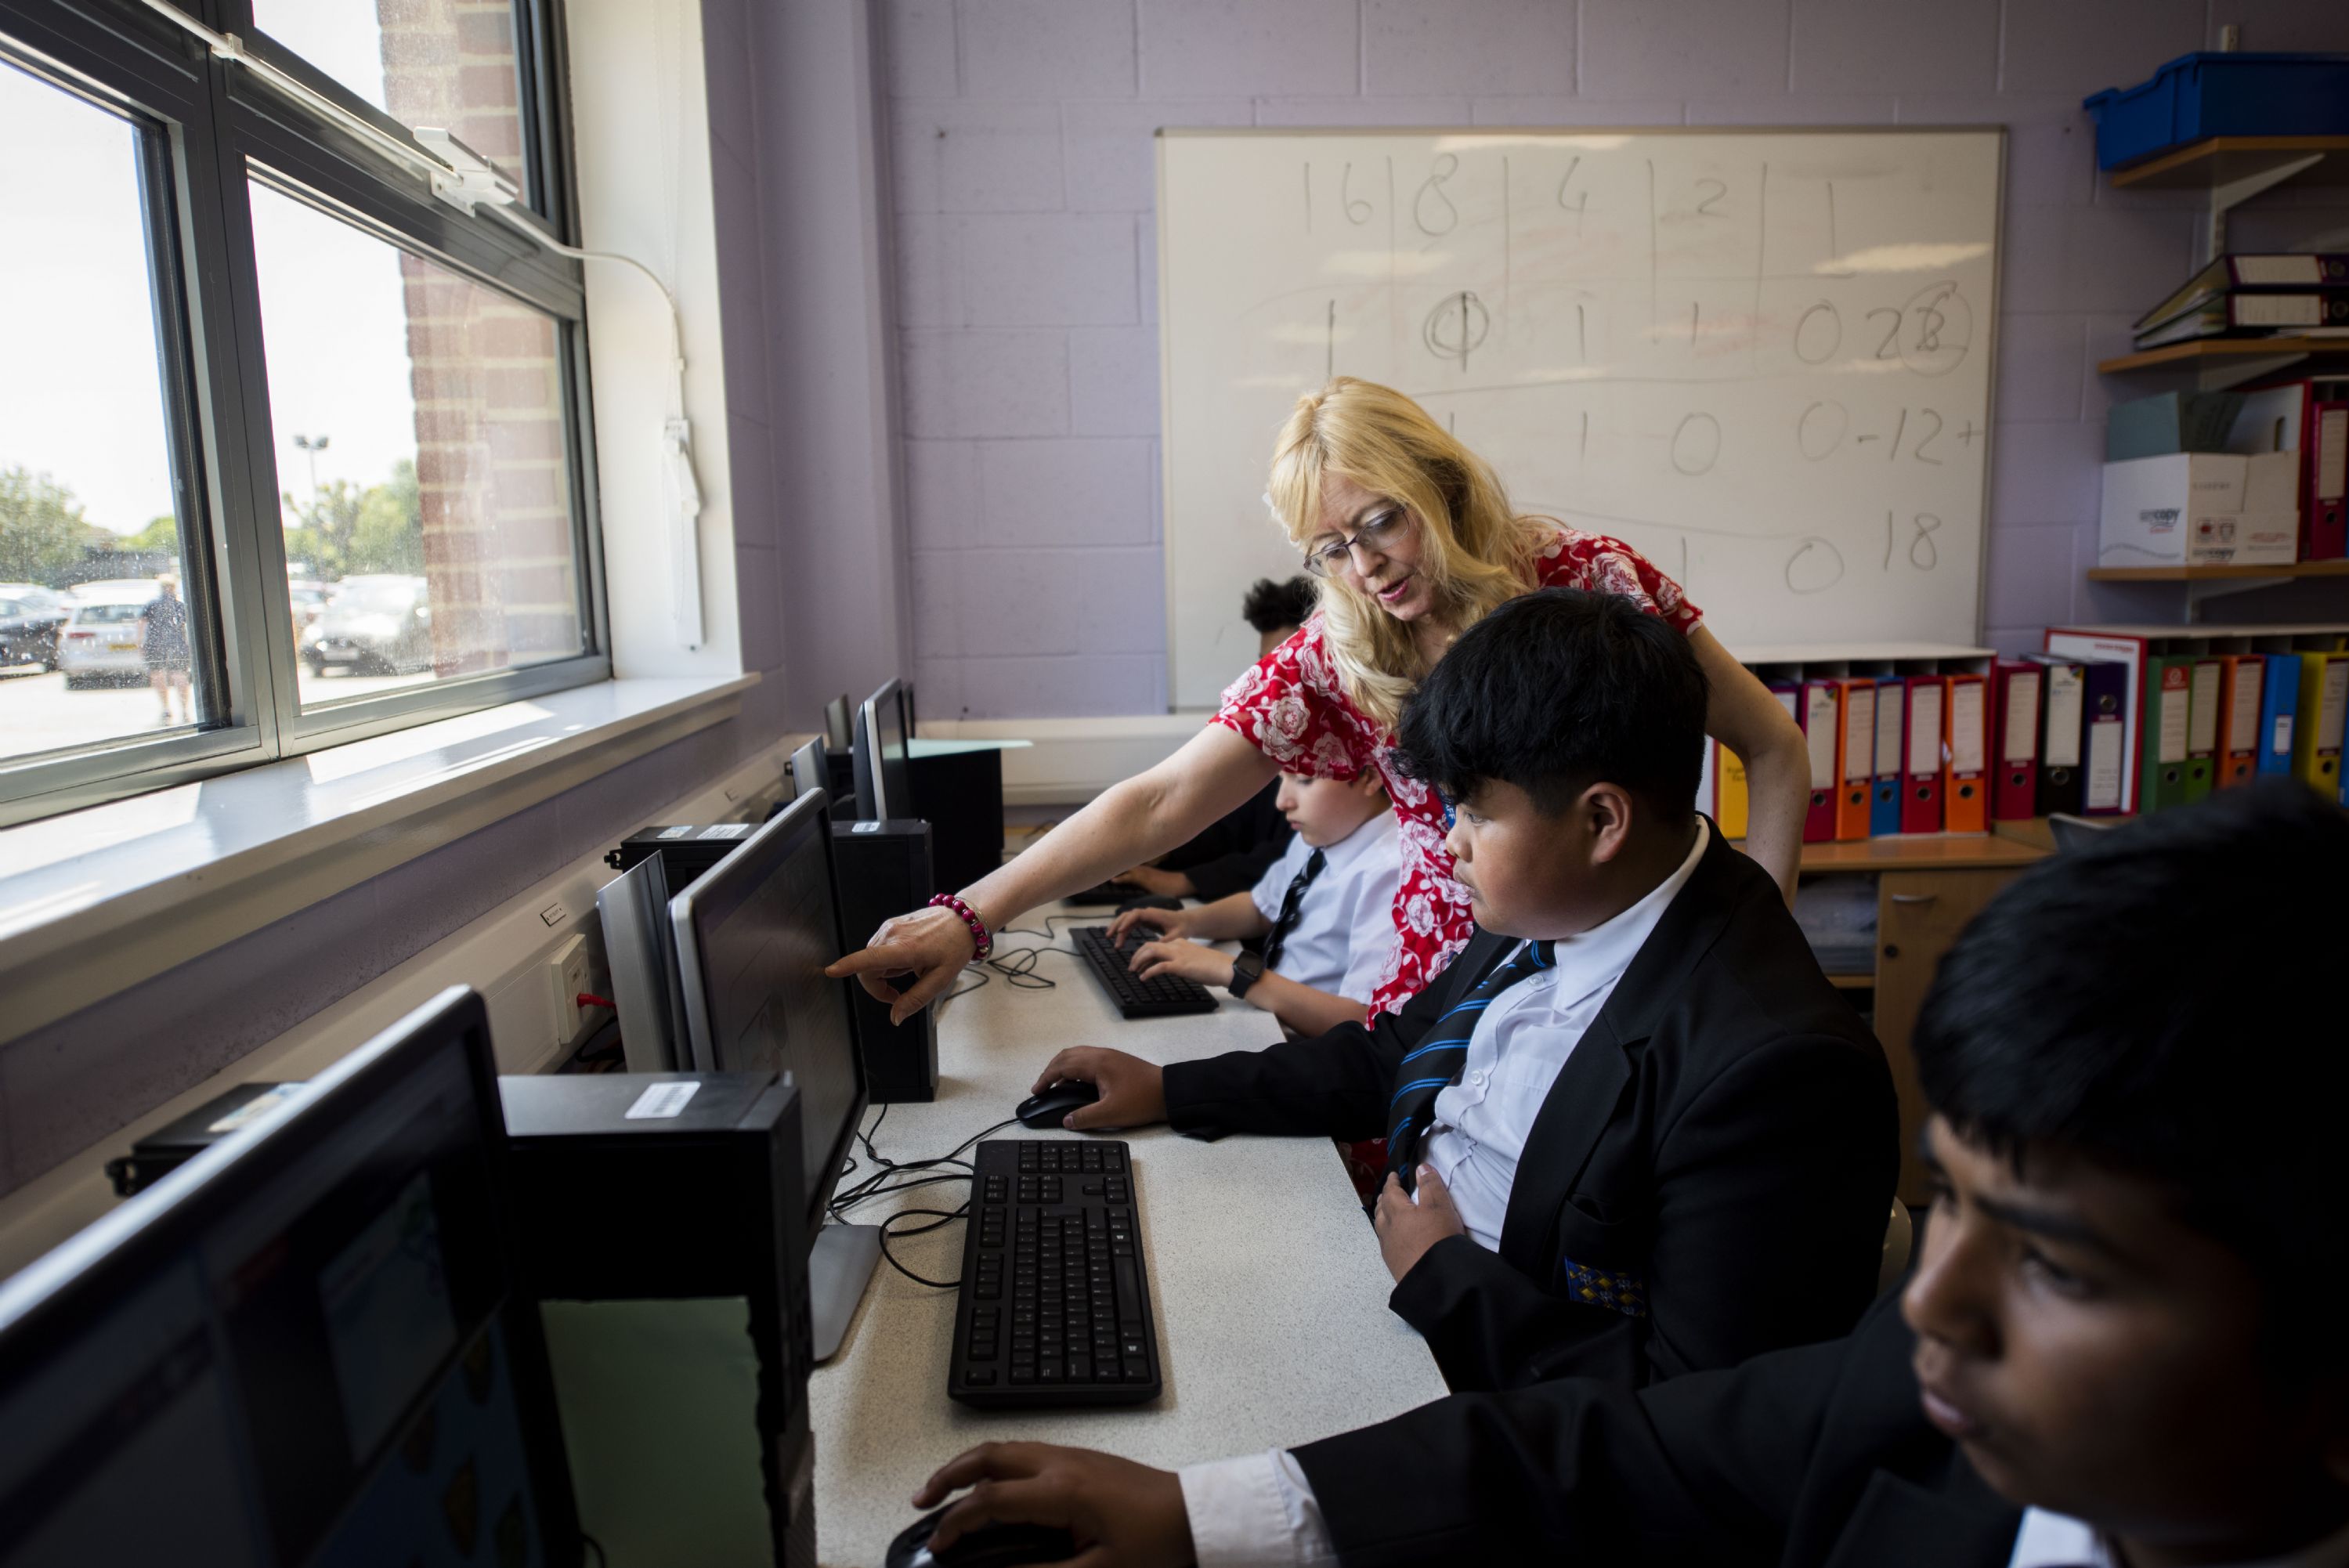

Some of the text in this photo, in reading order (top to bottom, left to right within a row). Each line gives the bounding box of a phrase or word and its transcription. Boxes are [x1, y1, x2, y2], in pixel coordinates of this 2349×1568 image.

[1304, 162, 1373, 234] 16
[1413, 153, 1458, 237] 8
[1558, 157, 1603, 237] 4
[1695, 178, 1728, 217] 2
[1577, 304, 1586, 362] 1
[1691, 302, 1699, 346] 1
[1795, 298, 1841, 364] 0
[1581, 411, 1588, 461] 1
[1671, 412, 1721, 475] 0
[1798, 399, 1849, 462] 0
[1786, 536, 1845, 595] 0
[1885, 510, 1942, 572] 18
